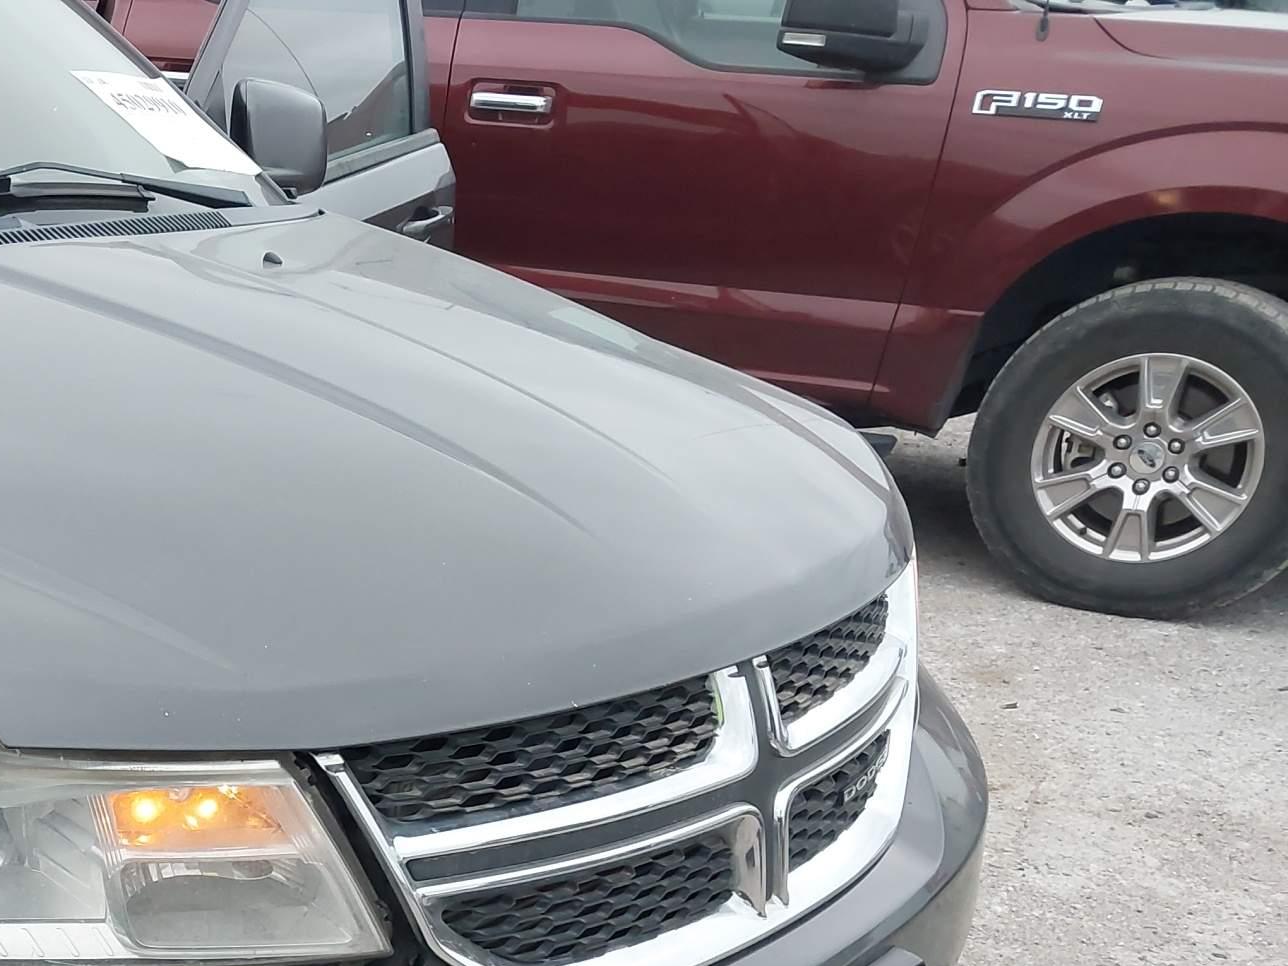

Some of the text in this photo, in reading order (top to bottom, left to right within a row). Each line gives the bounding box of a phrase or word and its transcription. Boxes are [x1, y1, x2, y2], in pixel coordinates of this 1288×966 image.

[971, 89, 1103, 114] F150
[1062, 111, 1090, 120] XLT
[844, 750, 888, 802] DODG
